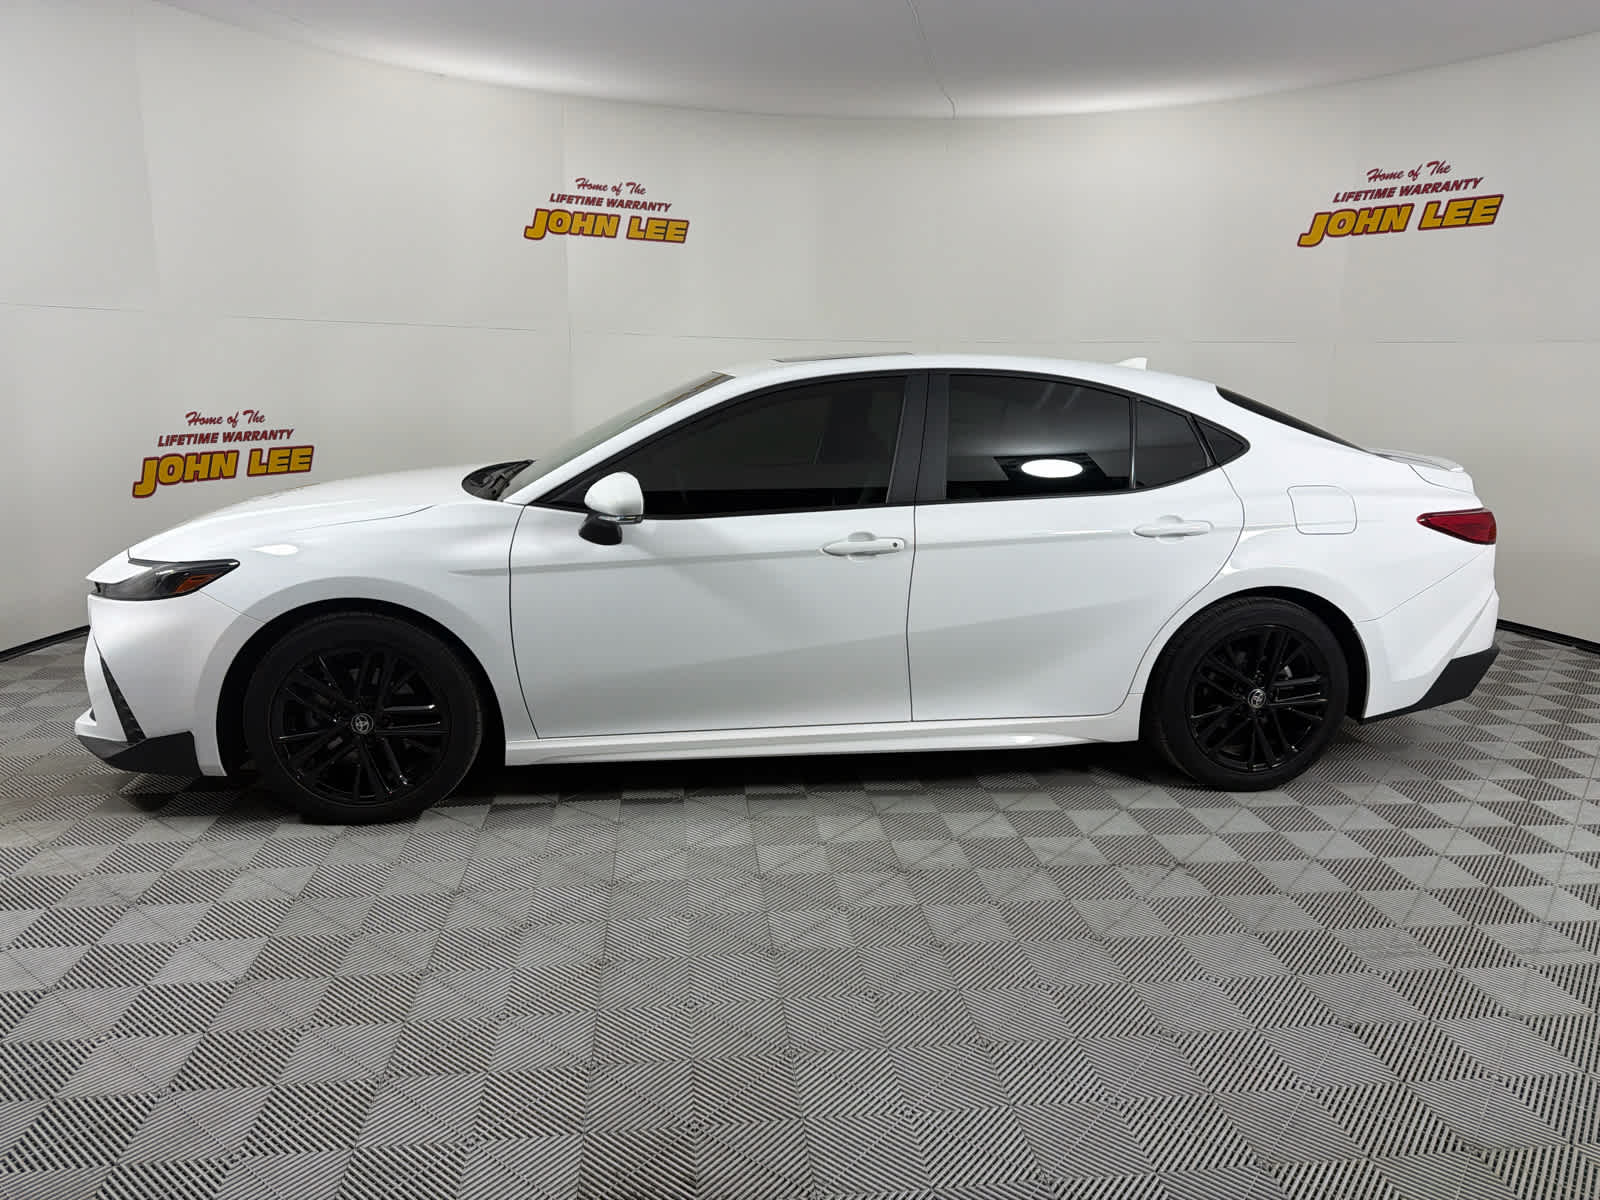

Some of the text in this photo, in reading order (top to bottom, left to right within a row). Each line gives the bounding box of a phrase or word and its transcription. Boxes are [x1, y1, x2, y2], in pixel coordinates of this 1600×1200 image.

[1366, 160, 1451, 183] Home of The
[575, 177, 646, 196] Home of The
[1332, 177, 1484, 203] LIFETIME WARRANTY
[549, 193, 672, 213] LIFETIME WARRANTY
[524, 208, 690, 243] JOHN LEE
[1297, 194, 1504, 247] JOHN LEE
[185, 409, 265, 428] Home of The
[157, 428, 294, 447] LIFETIME WARRANTY
[132, 445, 314, 498] JOHN LEE
